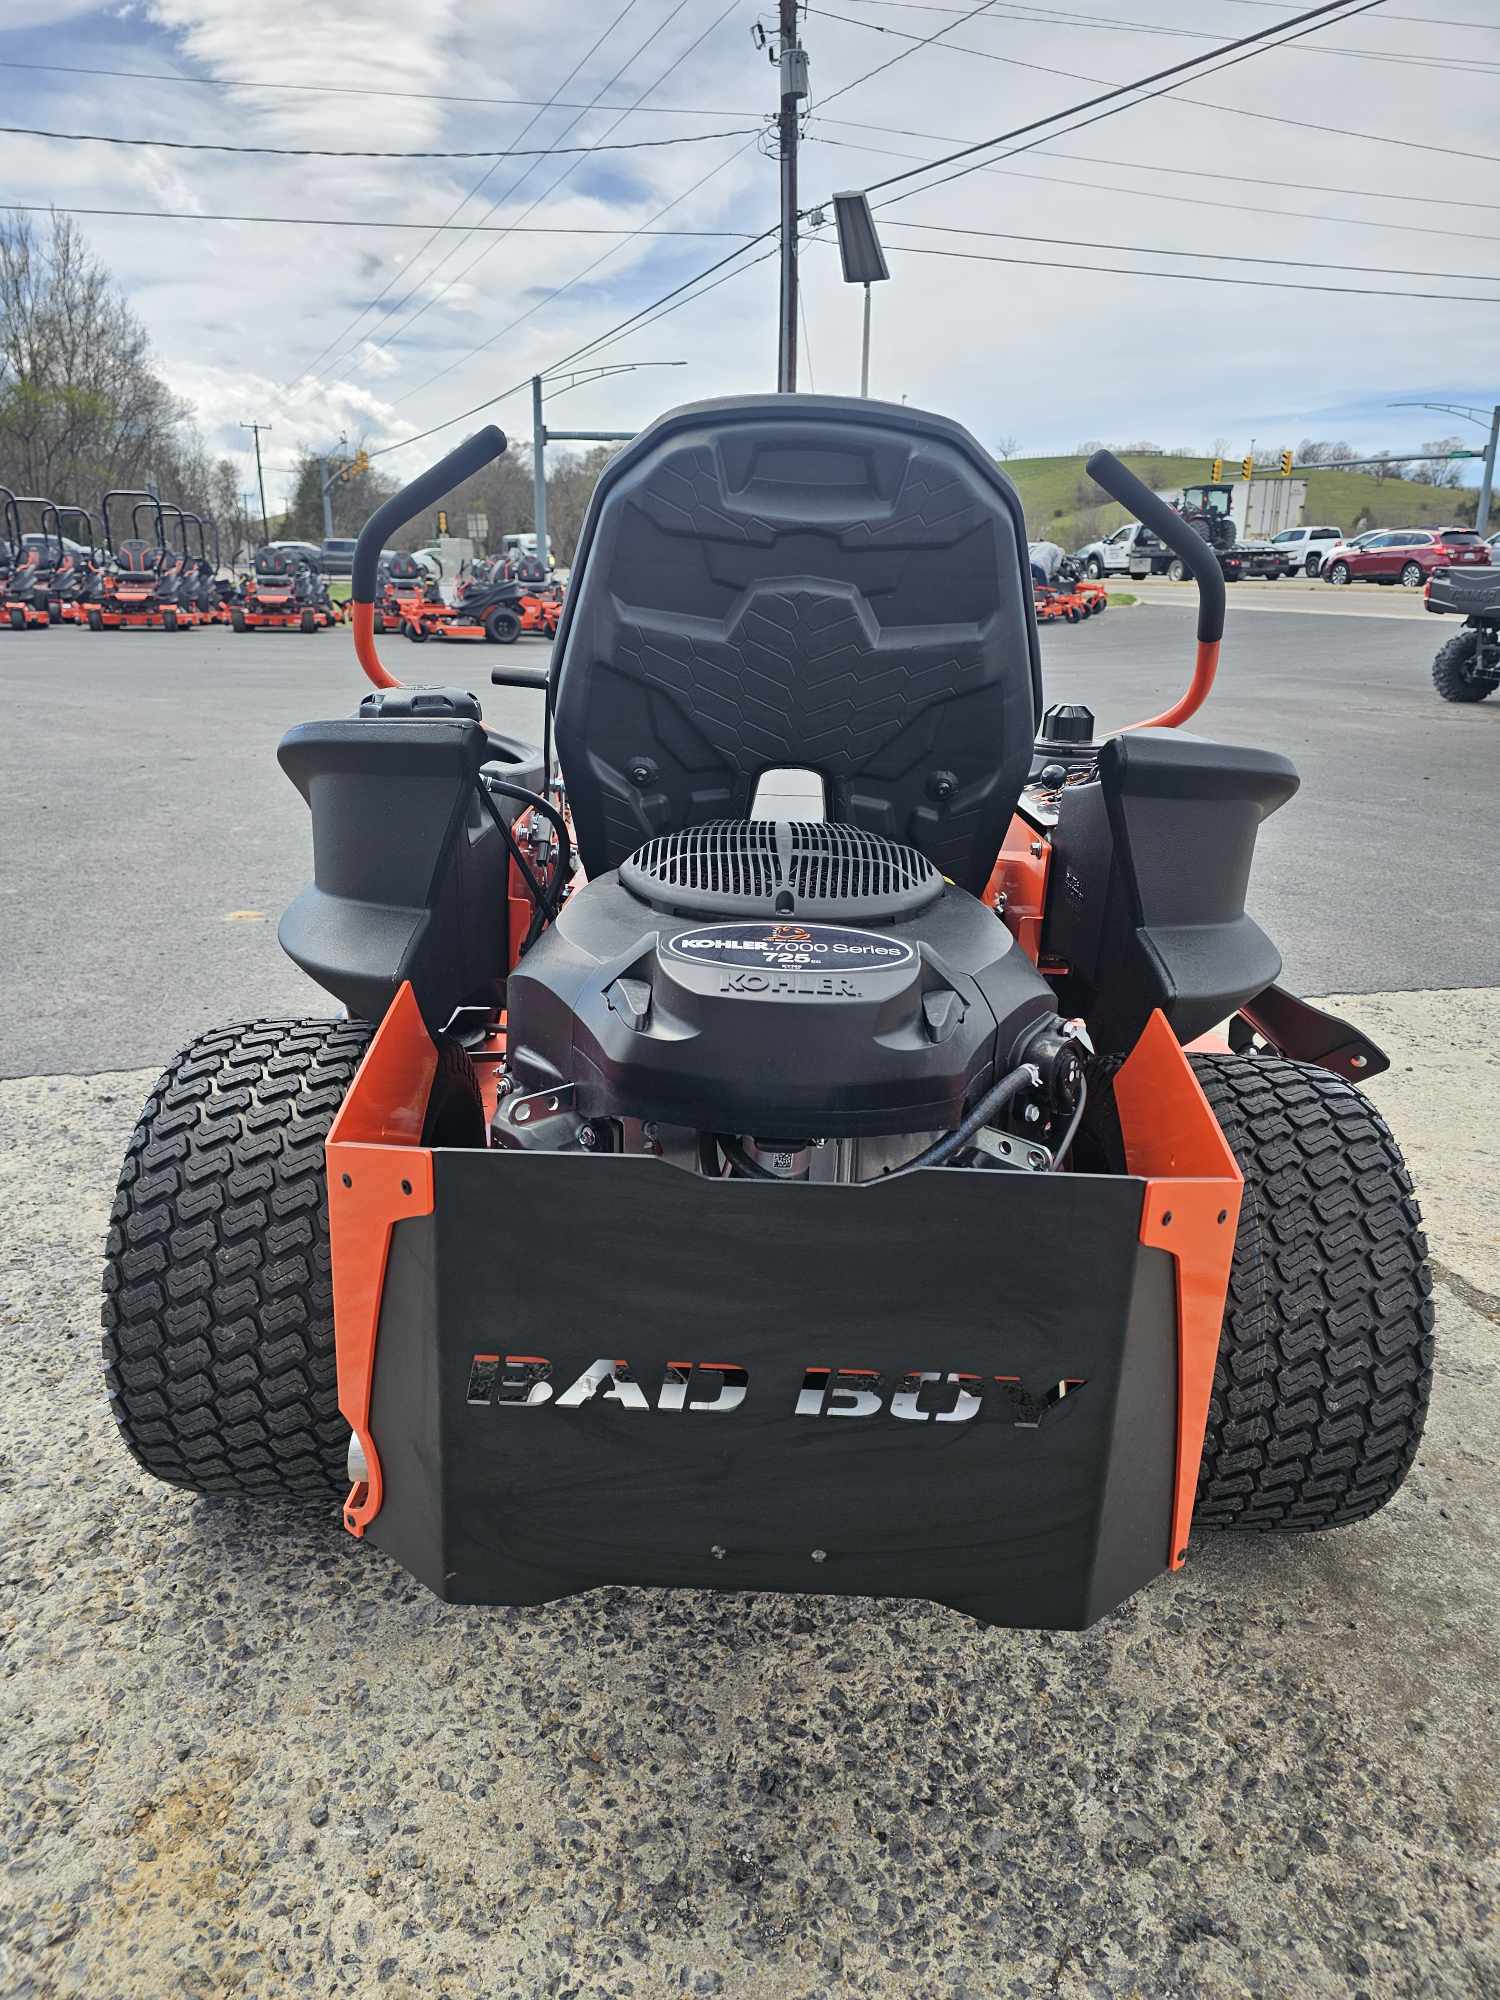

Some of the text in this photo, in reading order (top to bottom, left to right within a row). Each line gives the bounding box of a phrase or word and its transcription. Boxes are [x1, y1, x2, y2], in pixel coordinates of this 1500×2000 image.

[682, 939, 901, 956] KOHLER 7000 Series
[763, 952, 810, 963] 725
[720, 973, 857, 996] KOHLER
[466, 1354, 1090, 1429] BAD BOY
